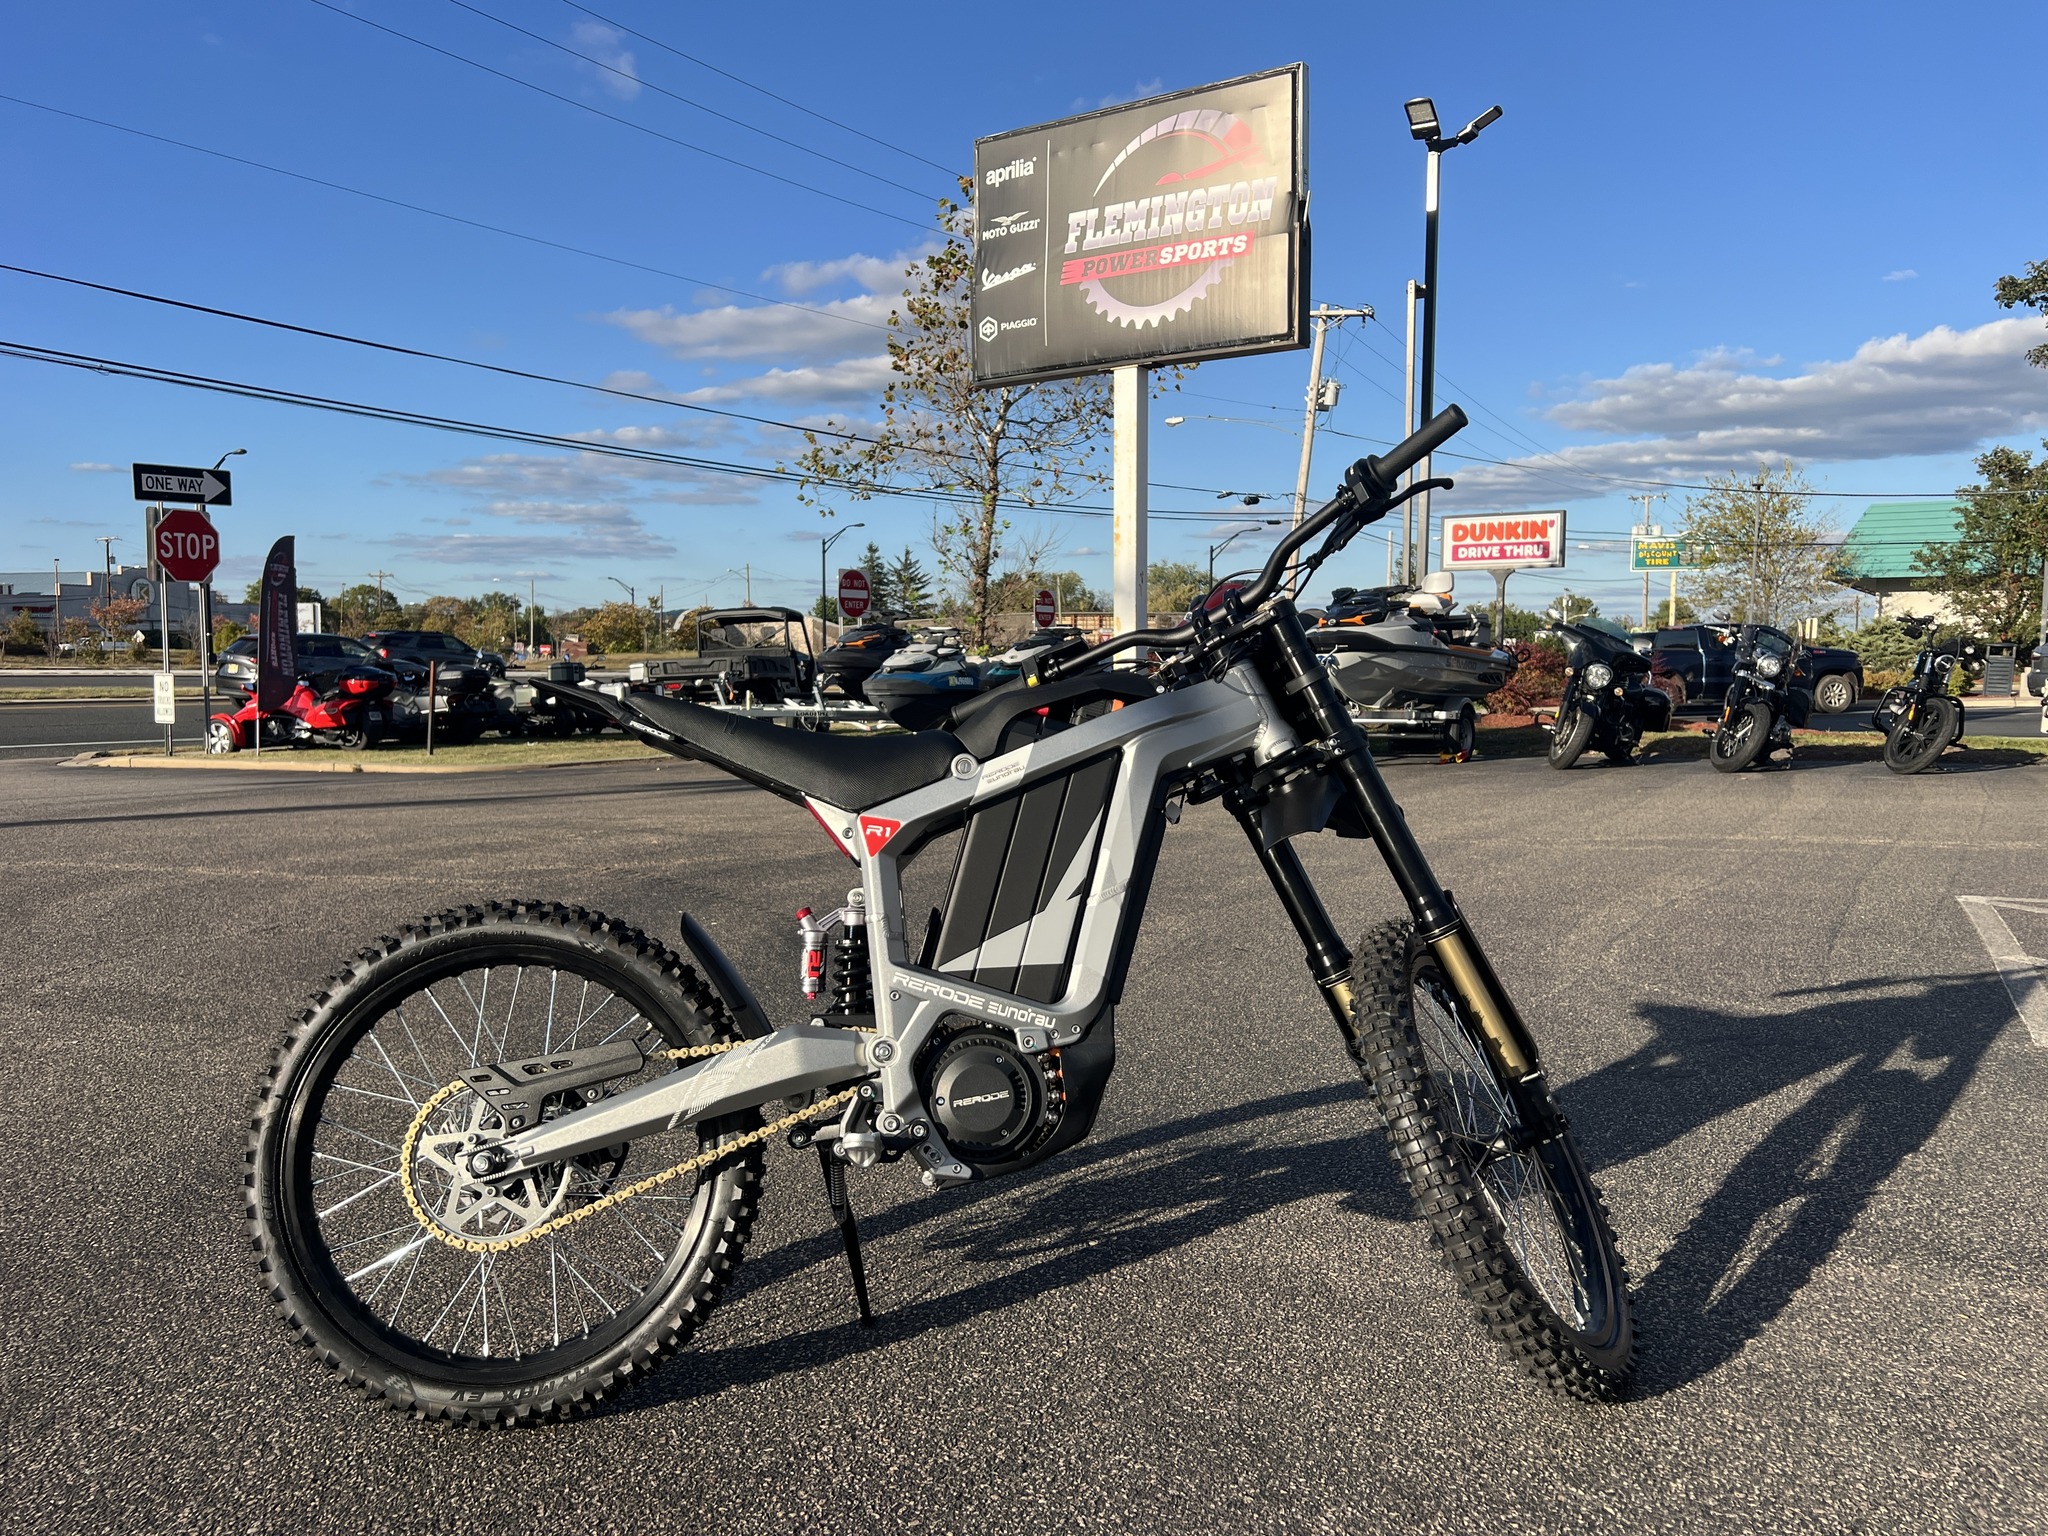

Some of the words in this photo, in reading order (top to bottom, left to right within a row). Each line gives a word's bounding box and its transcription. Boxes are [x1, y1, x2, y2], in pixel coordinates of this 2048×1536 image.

[985, 158, 1036, 188] aprilia
[1064, 175, 1278, 254] FLEMINGTON
[982, 226, 1008, 241] MOTO
[1009, 218, 1039, 235] GUZZI
[981, 262, 1036, 292] Vespa
[1000, 317, 1037, 331] PIAGGIO
[145, 475, 174, 491] ONE
[177, 478, 204, 493] WAY
[1452, 519, 1555, 542] DUNKIN'
[160, 531, 215, 560] STOP
[1457, 545, 1500, 559] DRIVE
[1503, 544, 1544, 557] THRU
[1637, 541, 1676, 550] MAVIS
[1638, 550, 1678, 558] DISCOUNT
[842, 578, 851, 587] DO
[853, 579, 866, 588] NOT
[844, 600, 864, 609] ENTER
[159, 681, 169, 692] NO
[865, 824, 892, 838] R1
[892, 972, 986, 1010] RERODE
[952, 1089, 1010, 1108] RERODE
[450, 1390, 486, 1403] EV
